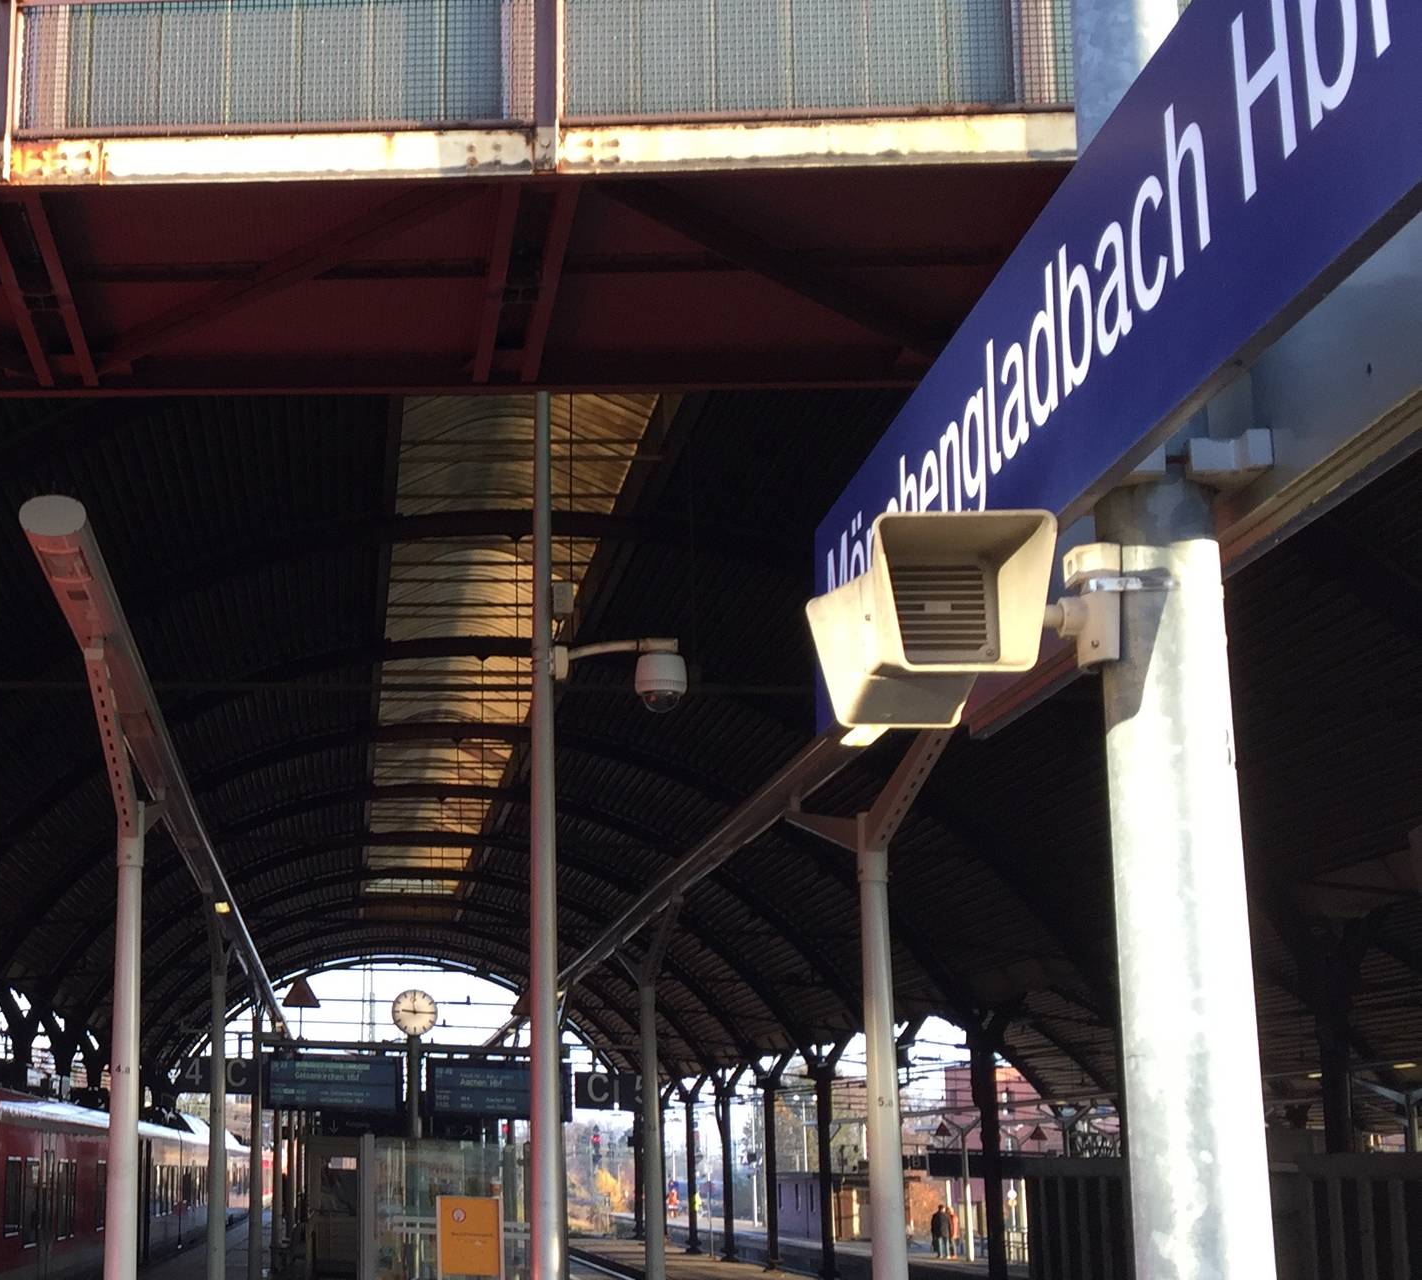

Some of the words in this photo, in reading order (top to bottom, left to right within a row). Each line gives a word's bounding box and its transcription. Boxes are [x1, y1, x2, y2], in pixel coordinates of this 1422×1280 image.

[184, 1058, 203, 1086] 4
[226, 1059, 247, 1087] C
[587, 1073, 610, 1103] C
